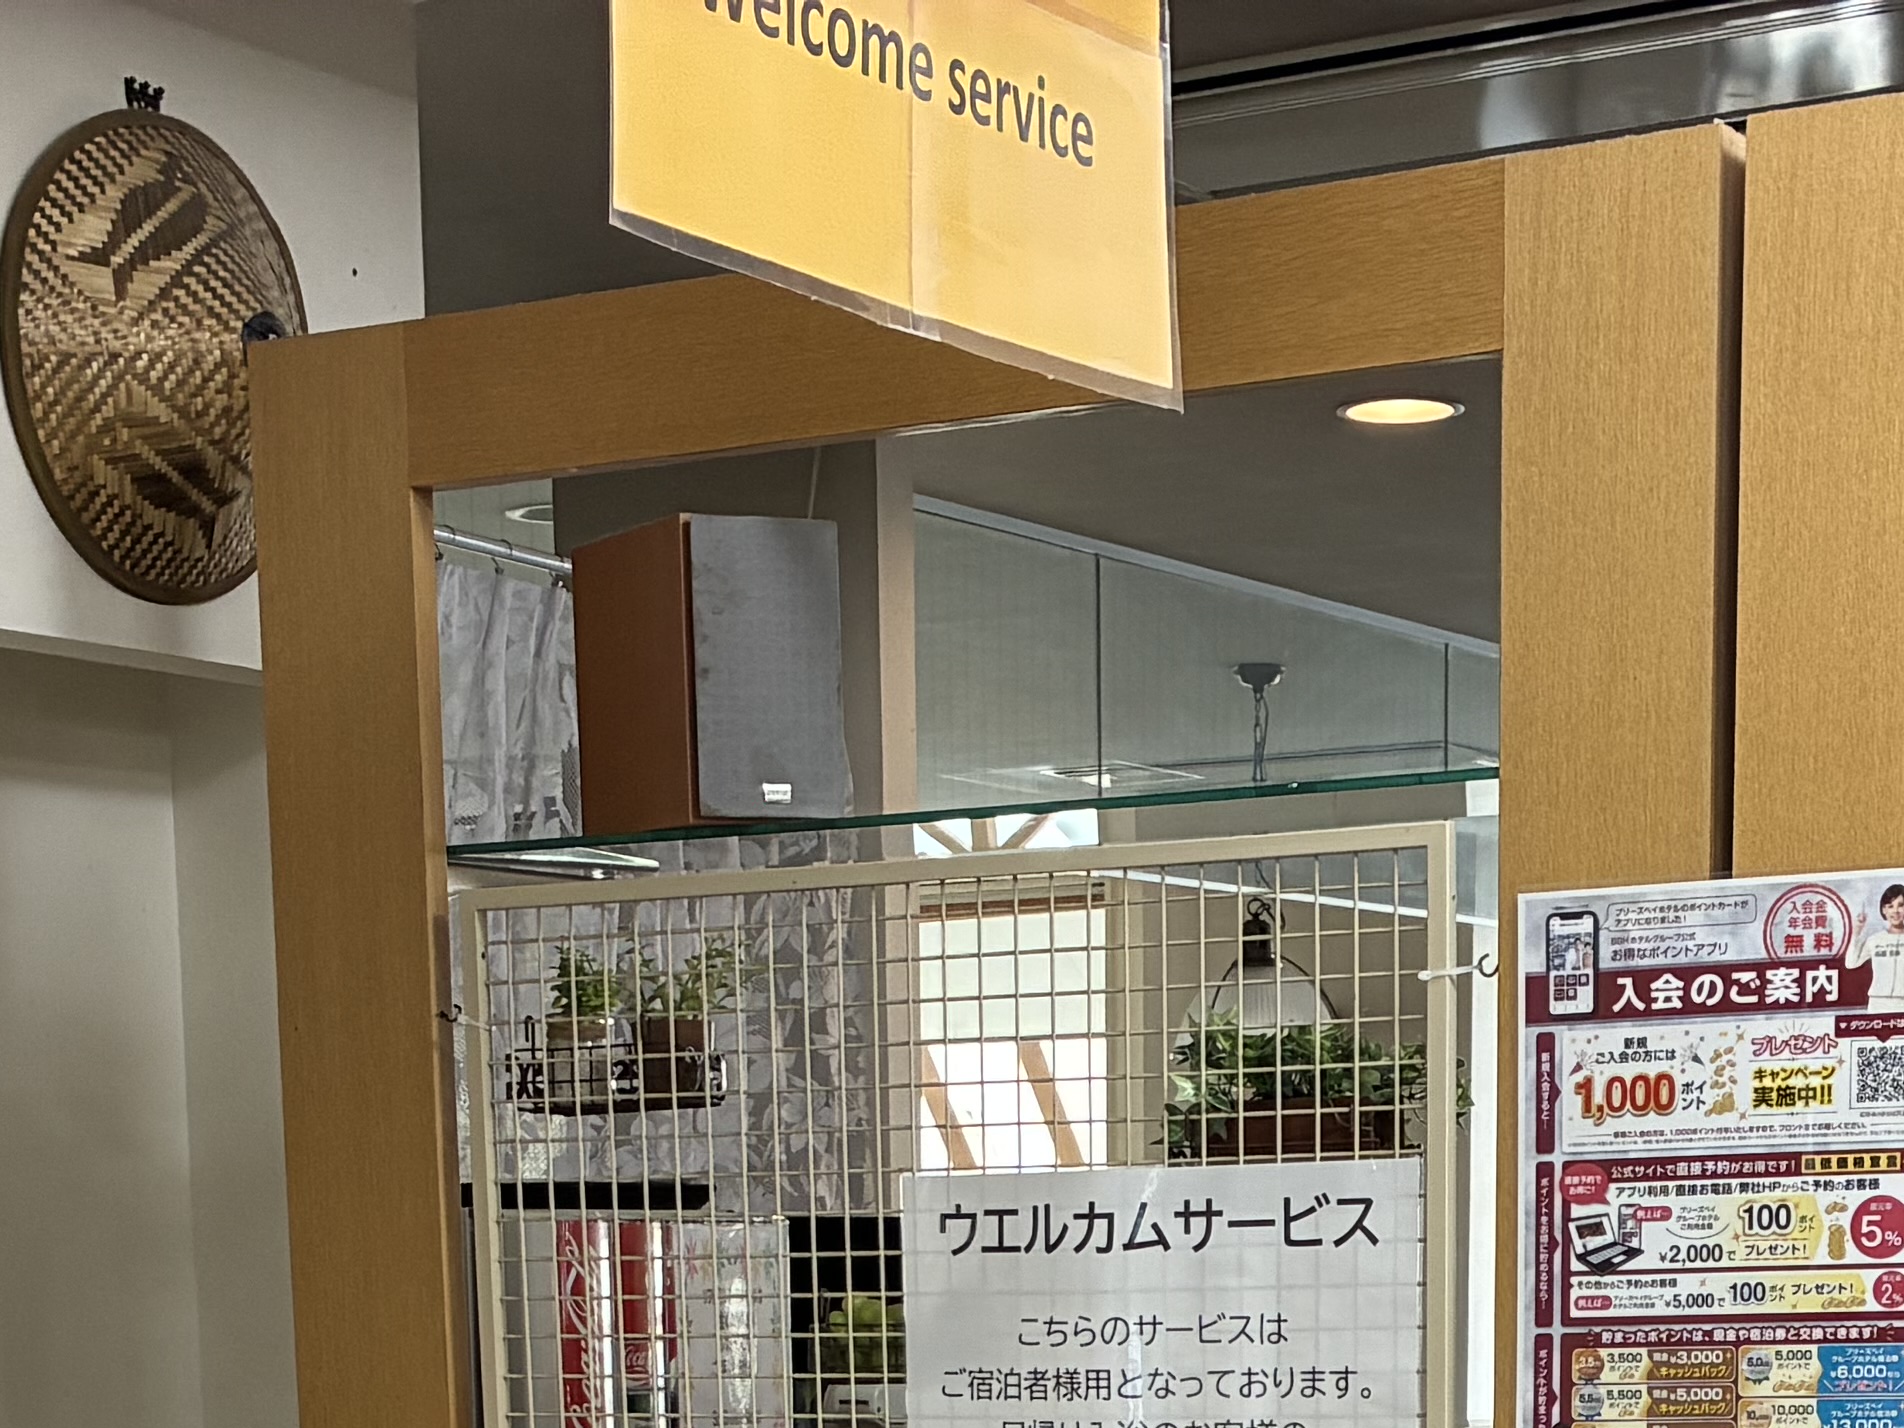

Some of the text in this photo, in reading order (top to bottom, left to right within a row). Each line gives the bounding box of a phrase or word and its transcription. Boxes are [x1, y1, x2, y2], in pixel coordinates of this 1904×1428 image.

[705, 0, 1093, 167] elcome service
[1790, 900, 1828, 915] 入会金
[1611, 942, 1729, 962] お得なポイントアプリ
[1784, 932, 1835, 954] 無料
[1612, 964, 1839, 1013] 入会のご案内
[1624, 1037, 1648, 1049] 新規
[1752, 1034, 1838, 1056] プレゼント
[1596, 1050, 1676, 1064] ご入会の方には
[1753, 1065, 1836, 1082] キャンペーン
[1574, 1071, 1677, 1126] 1,000
[1752, 1084, 1832, 1108] 実施中!!
[939, 1192, 1380, 1256] ウエルカムサービス
[1741, 1203, 1792, 1231] 100
[1729, 1282, 1766, 1303] 100
[1018, 1313, 1289, 1347] こちらのサービスは
[1606, 1353, 1643, 1364] 3,500
[1775, 1350, 1812, 1361] 5,000
[1659, 1366, 1727, 1377] キャッシュバック
[942, 1367, 1373, 1402] ご宿泊者様用となっております。
[1606, 1389, 1643, 1401] 5,500
[1659, 1404, 1727, 1415] キャッシュバック
[1772, 1405, 1814, 1416] 10,000
